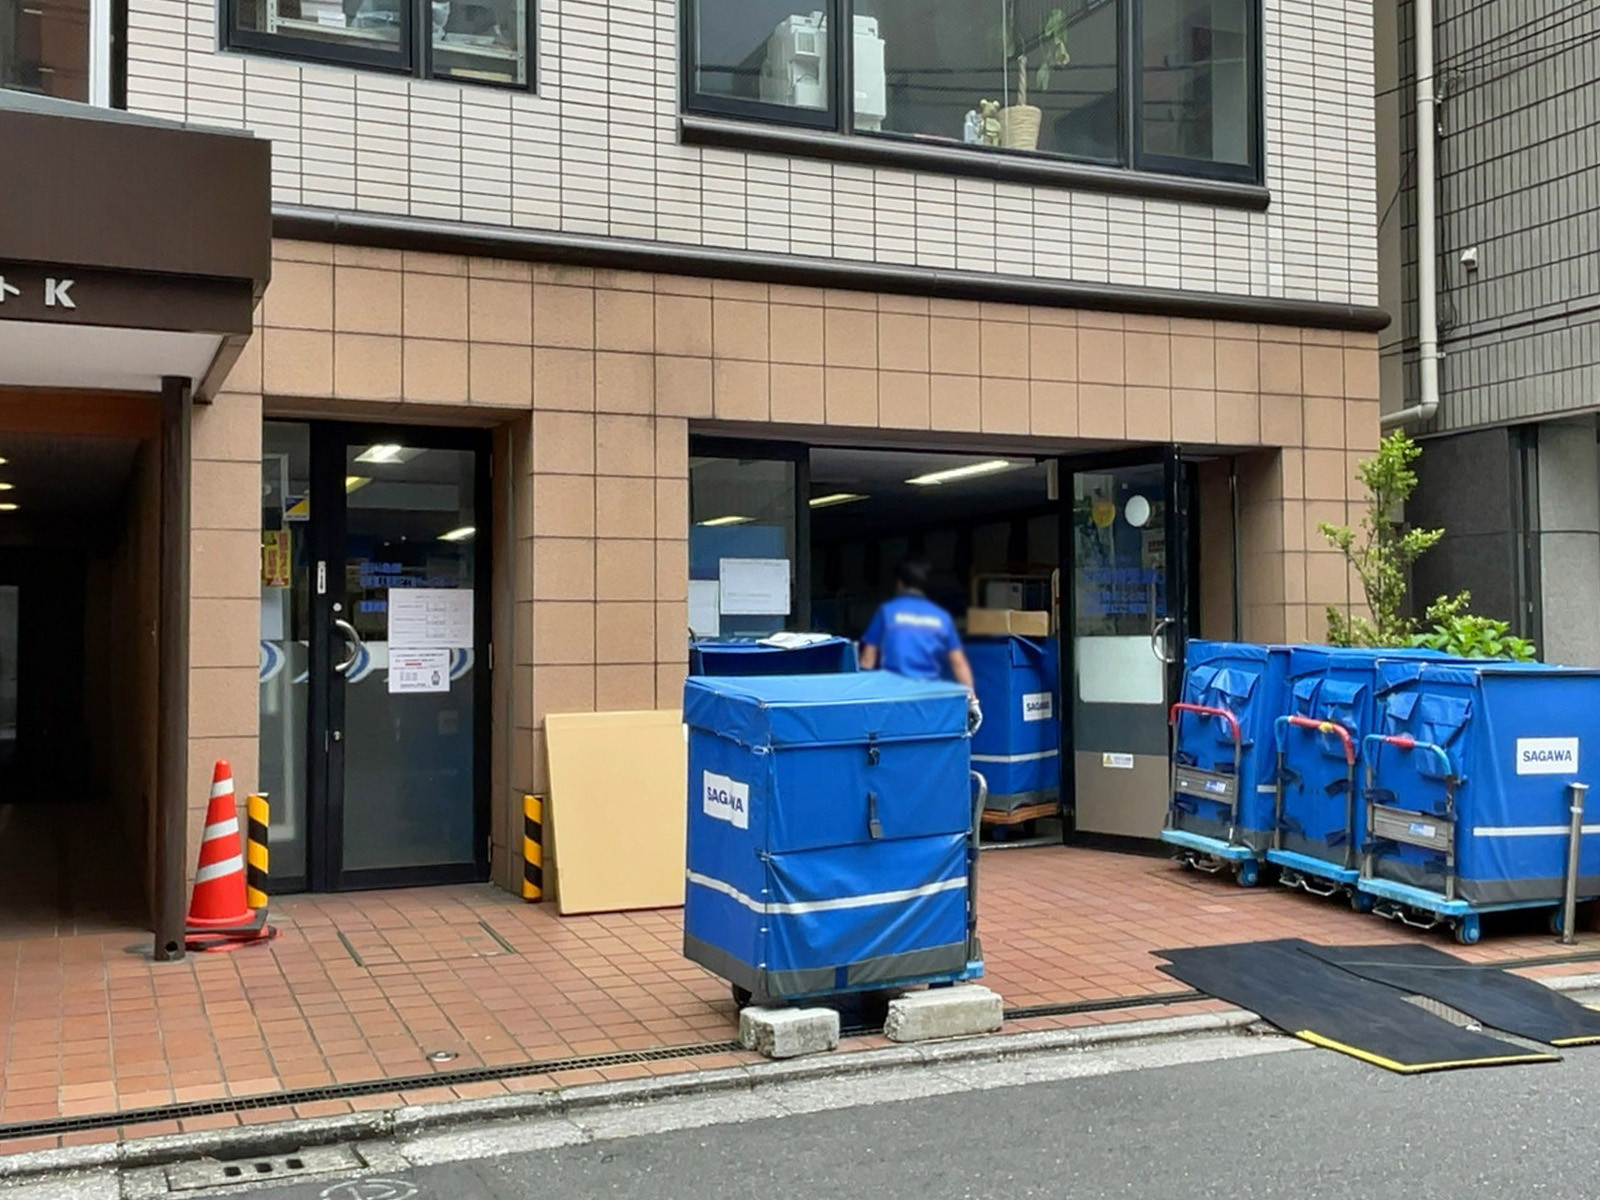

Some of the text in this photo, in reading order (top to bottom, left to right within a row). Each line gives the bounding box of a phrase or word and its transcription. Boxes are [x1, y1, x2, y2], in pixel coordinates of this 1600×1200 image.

[45, 278, 76, 308] K
[1523, 750, 1572, 762] SAGAWA
[707, 786, 744, 813] SAGWA
